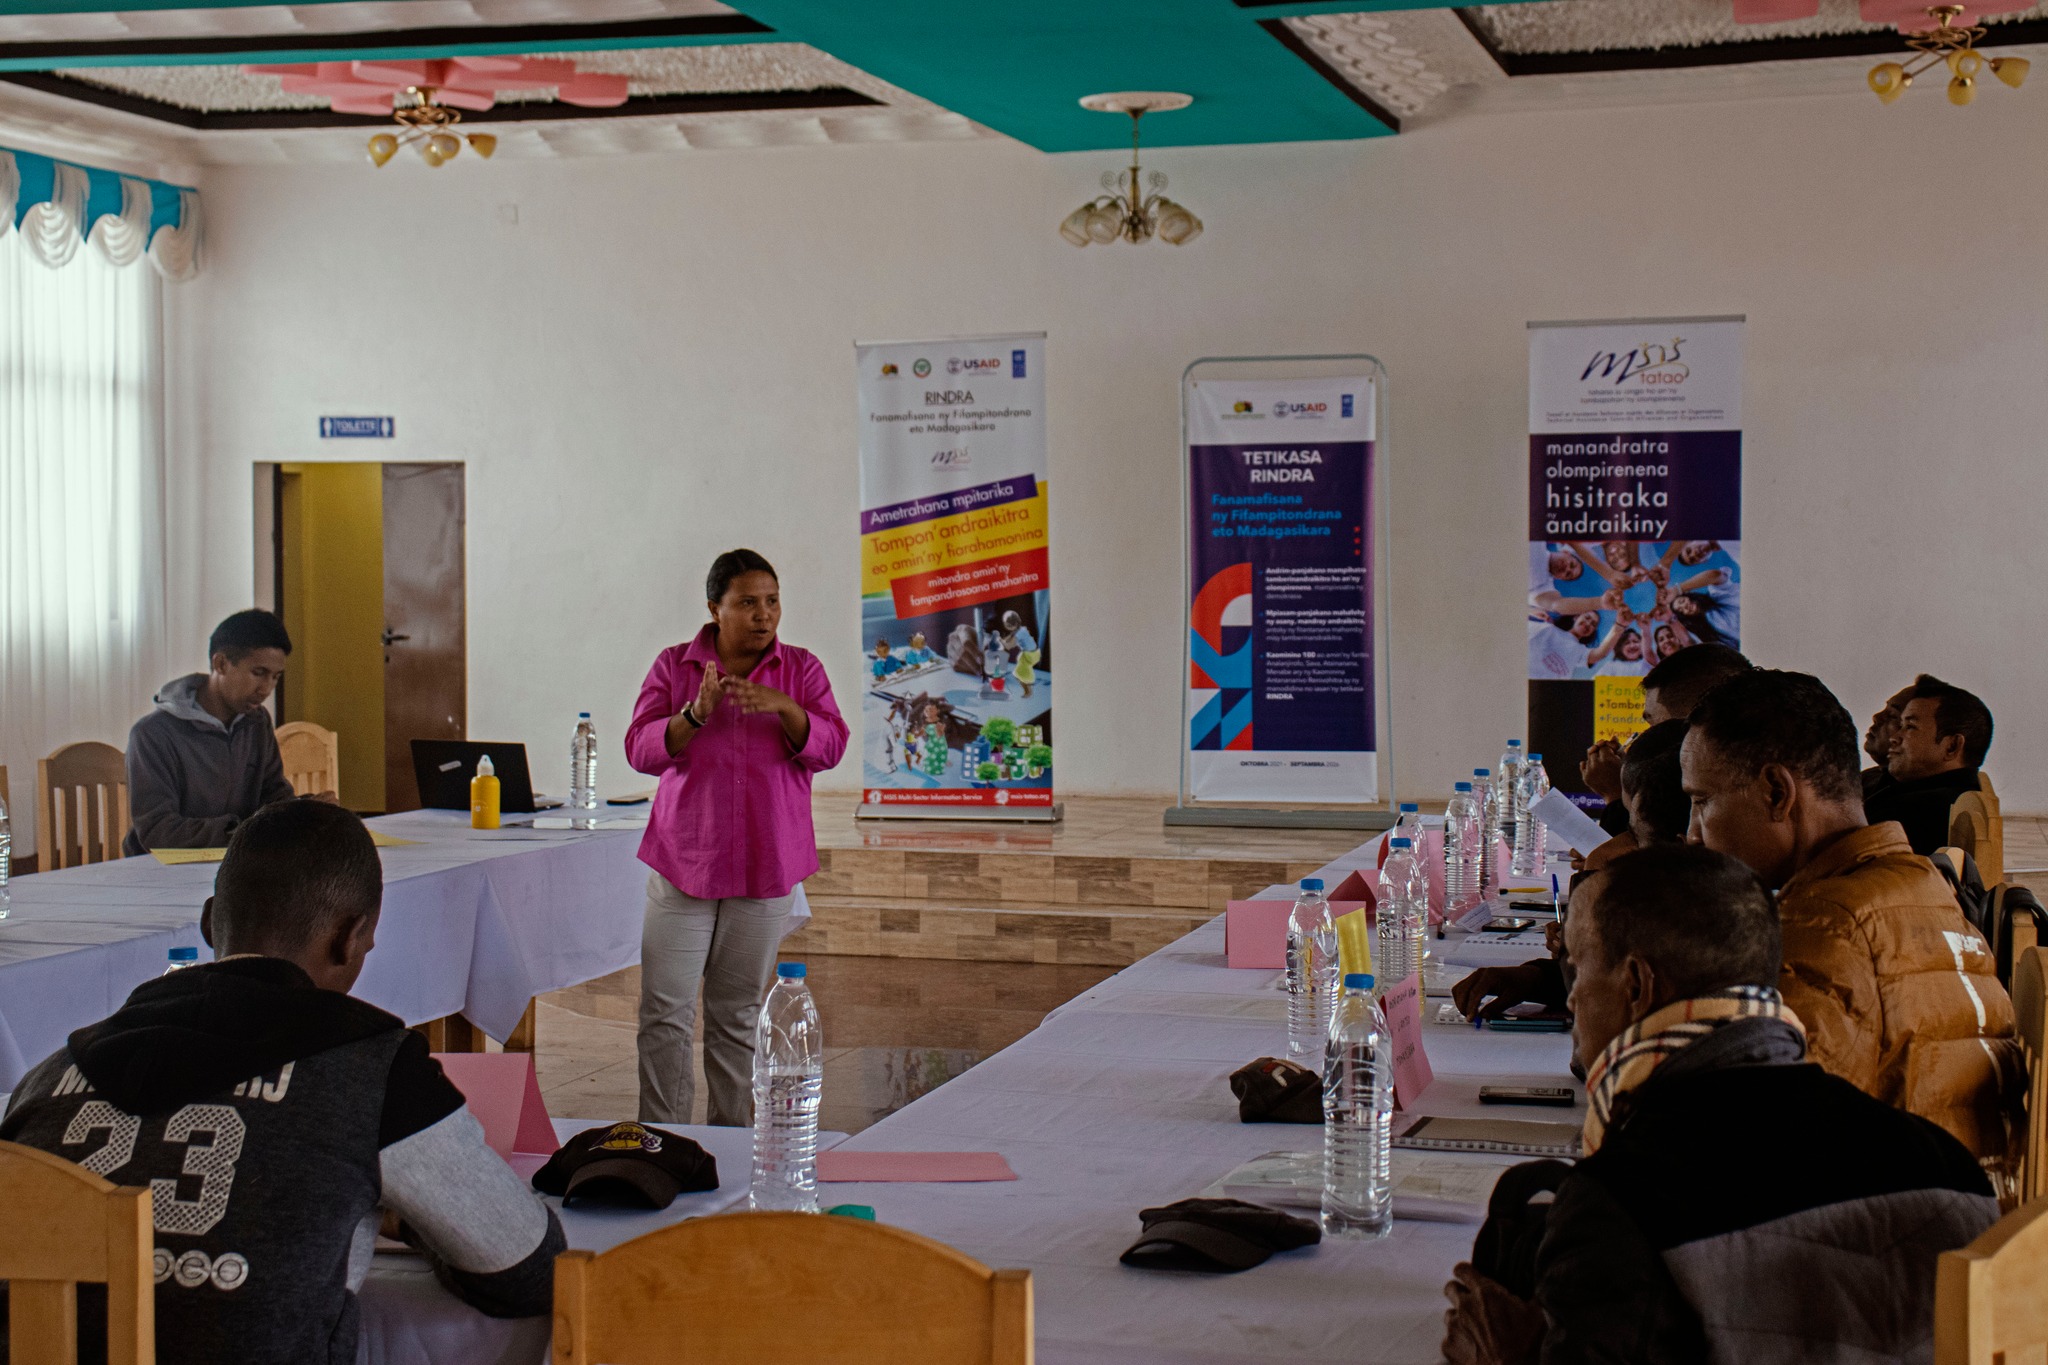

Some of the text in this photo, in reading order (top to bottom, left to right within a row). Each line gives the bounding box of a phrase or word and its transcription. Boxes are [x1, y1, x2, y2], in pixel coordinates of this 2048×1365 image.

[964, 358, 1000, 370] USAID
[1641, 371, 1684, 384] tatao
[925, 390, 975, 404] RINDRA
[1291, 402, 1327, 412] USAID
[871, 409, 935, 423] Fanamafisana
[938, 412, 949, 424] ny
[909, 420, 996, 435] eto Madagasikara
[1546, 435, 1668, 456] manandratra
[1243, 450, 1322, 465] TETIKASA
[1251, 468, 1315, 483] RINDRA
[1546, 459, 1668, 482] olompirenena
[1212, 492, 1303, 506] Fanamafisana
[1546, 481, 1668, 508] hisitraka
[870, 483, 1014, 526] Ametrahana mpitarika
[1212, 508, 1342, 524] ny Fifampitondrana
[1212, 525, 1331, 540] eto Madagasikara
[1546, 511, 1668, 539] andraikiny
[872, 528, 1043, 576] eo amin'ny fiarahamonina
[928, 563, 1011, 588] mitondra amin'ny
[910, 572, 1038, 607] fampandrosoana maharitra
[62, 1100, 246, 1235] 23
